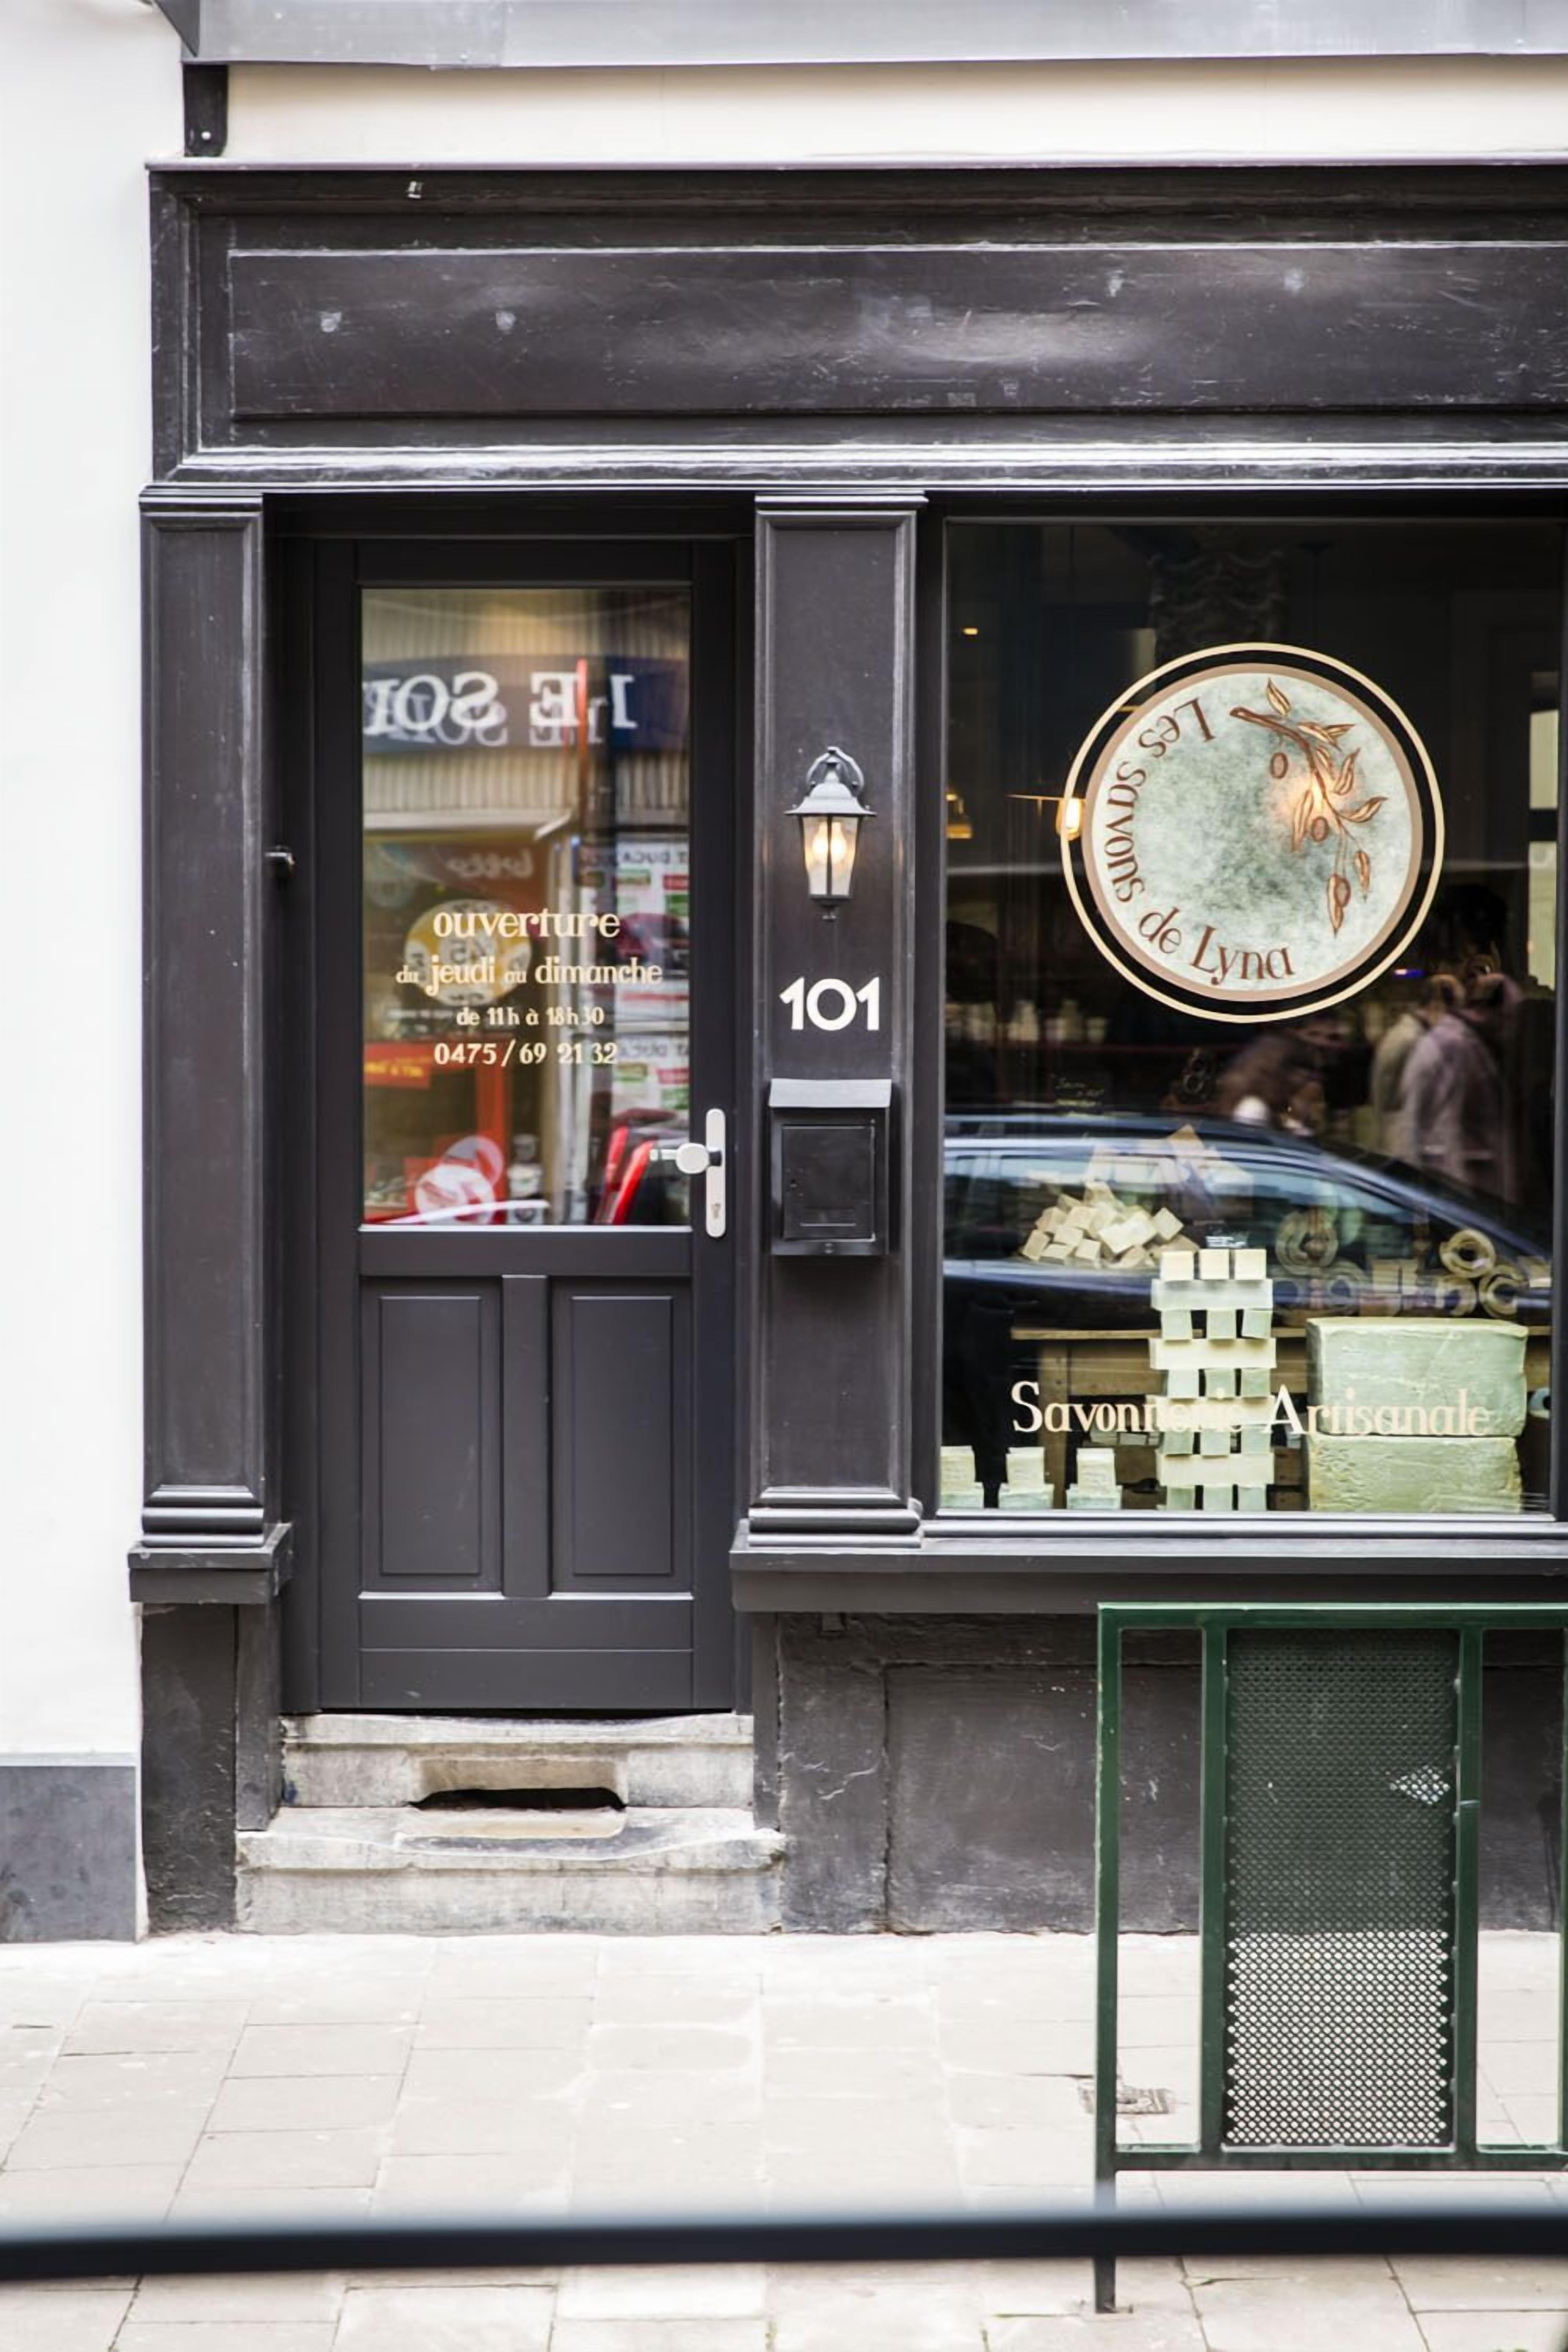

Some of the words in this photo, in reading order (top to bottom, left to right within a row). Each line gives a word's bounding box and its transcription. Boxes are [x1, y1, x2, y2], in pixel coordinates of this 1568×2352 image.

[1138, 697, 1216, 758] Les
[1103, 760, 1147, 903] savons
[433, 908, 621, 938] ouverture
[1138, 907, 1182, 954] de
[395, 965, 419, 984] du
[425, 955, 495, 997] jeudi
[504, 970, 527, 984] au
[535, 956, 663, 984] dimanche
[1189, 925, 1296, 985] Lyna
[456, 1007, 480, 1026] de
[525, 1008, 539, 1026] à
[779, 976, 880, 1031] 101
[1265, 1384, 1490, 1436] Artisanale
